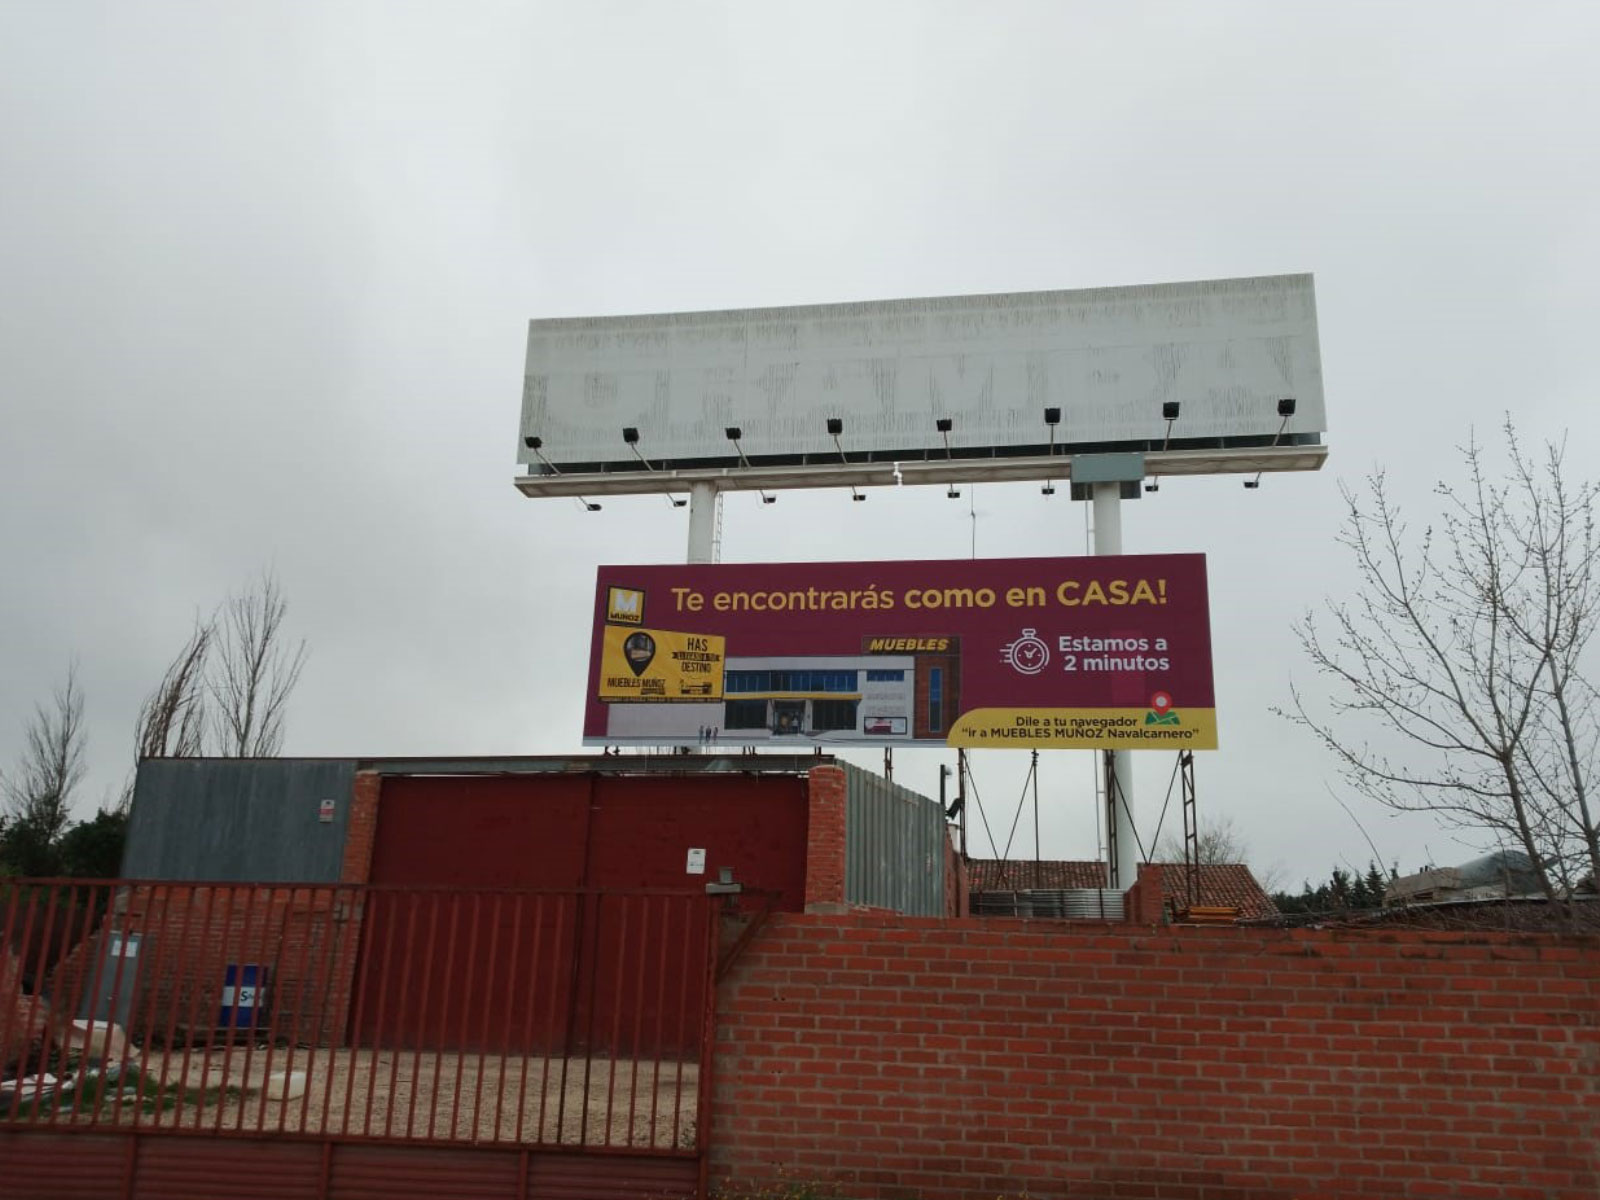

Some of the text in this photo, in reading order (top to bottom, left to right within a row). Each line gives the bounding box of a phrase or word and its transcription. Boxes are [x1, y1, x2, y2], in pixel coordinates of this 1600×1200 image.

[670, 579, 1167, 612] Te encontrarás como en CASA!
[687, 637, 708, 652] HAS
[871, 638, 949, 651] MUEBLES
[1058, 636, 1168, 653] Estamos a
[681, 661, 711, 673] DESTINO
[1063, 654, 1170, 672] 2 minutos
[1016, 716, 1138, 729] Dile a tu navegador
[980, 730, 988, 738] a
[991, 728, 1051, 738] MUEBLES
[1055, 726, 1103, 738] MUÑOZ
